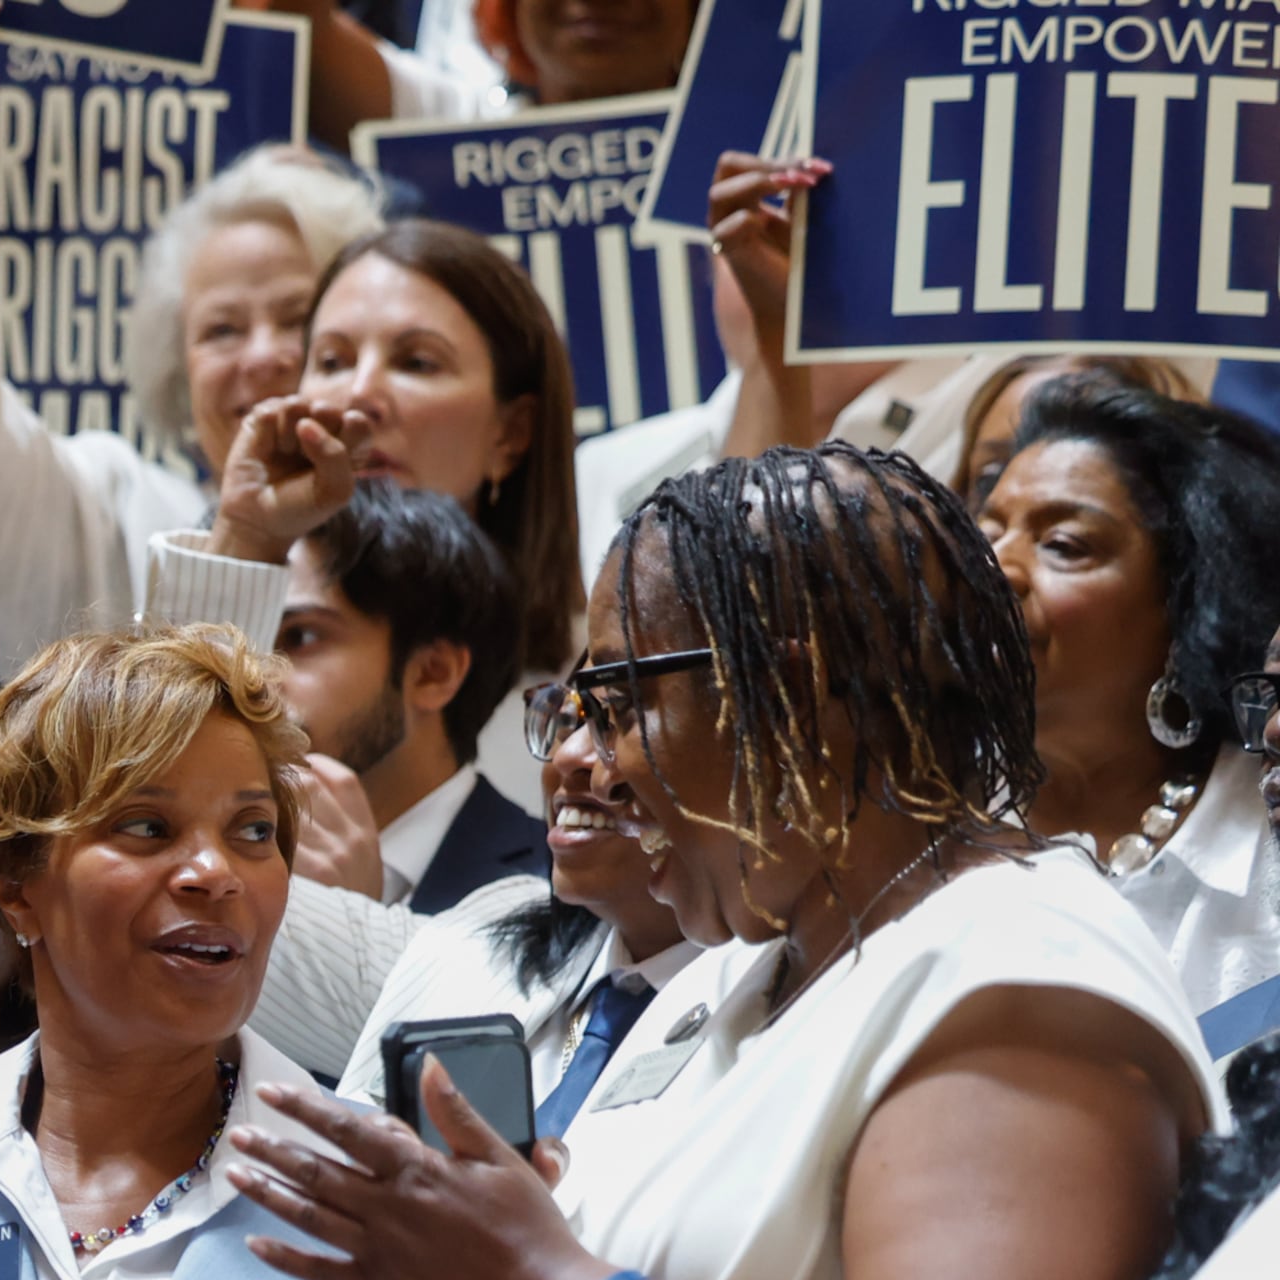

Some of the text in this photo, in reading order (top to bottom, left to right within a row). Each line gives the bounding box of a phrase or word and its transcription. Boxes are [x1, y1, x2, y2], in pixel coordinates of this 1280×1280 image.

[962, 16, 1280, 69] EMPOWE
[452, 126, 662, 188] RIGGED
[501, 174, 648, 232] EMPO
[891, 71, 1280, 317] ELITE
